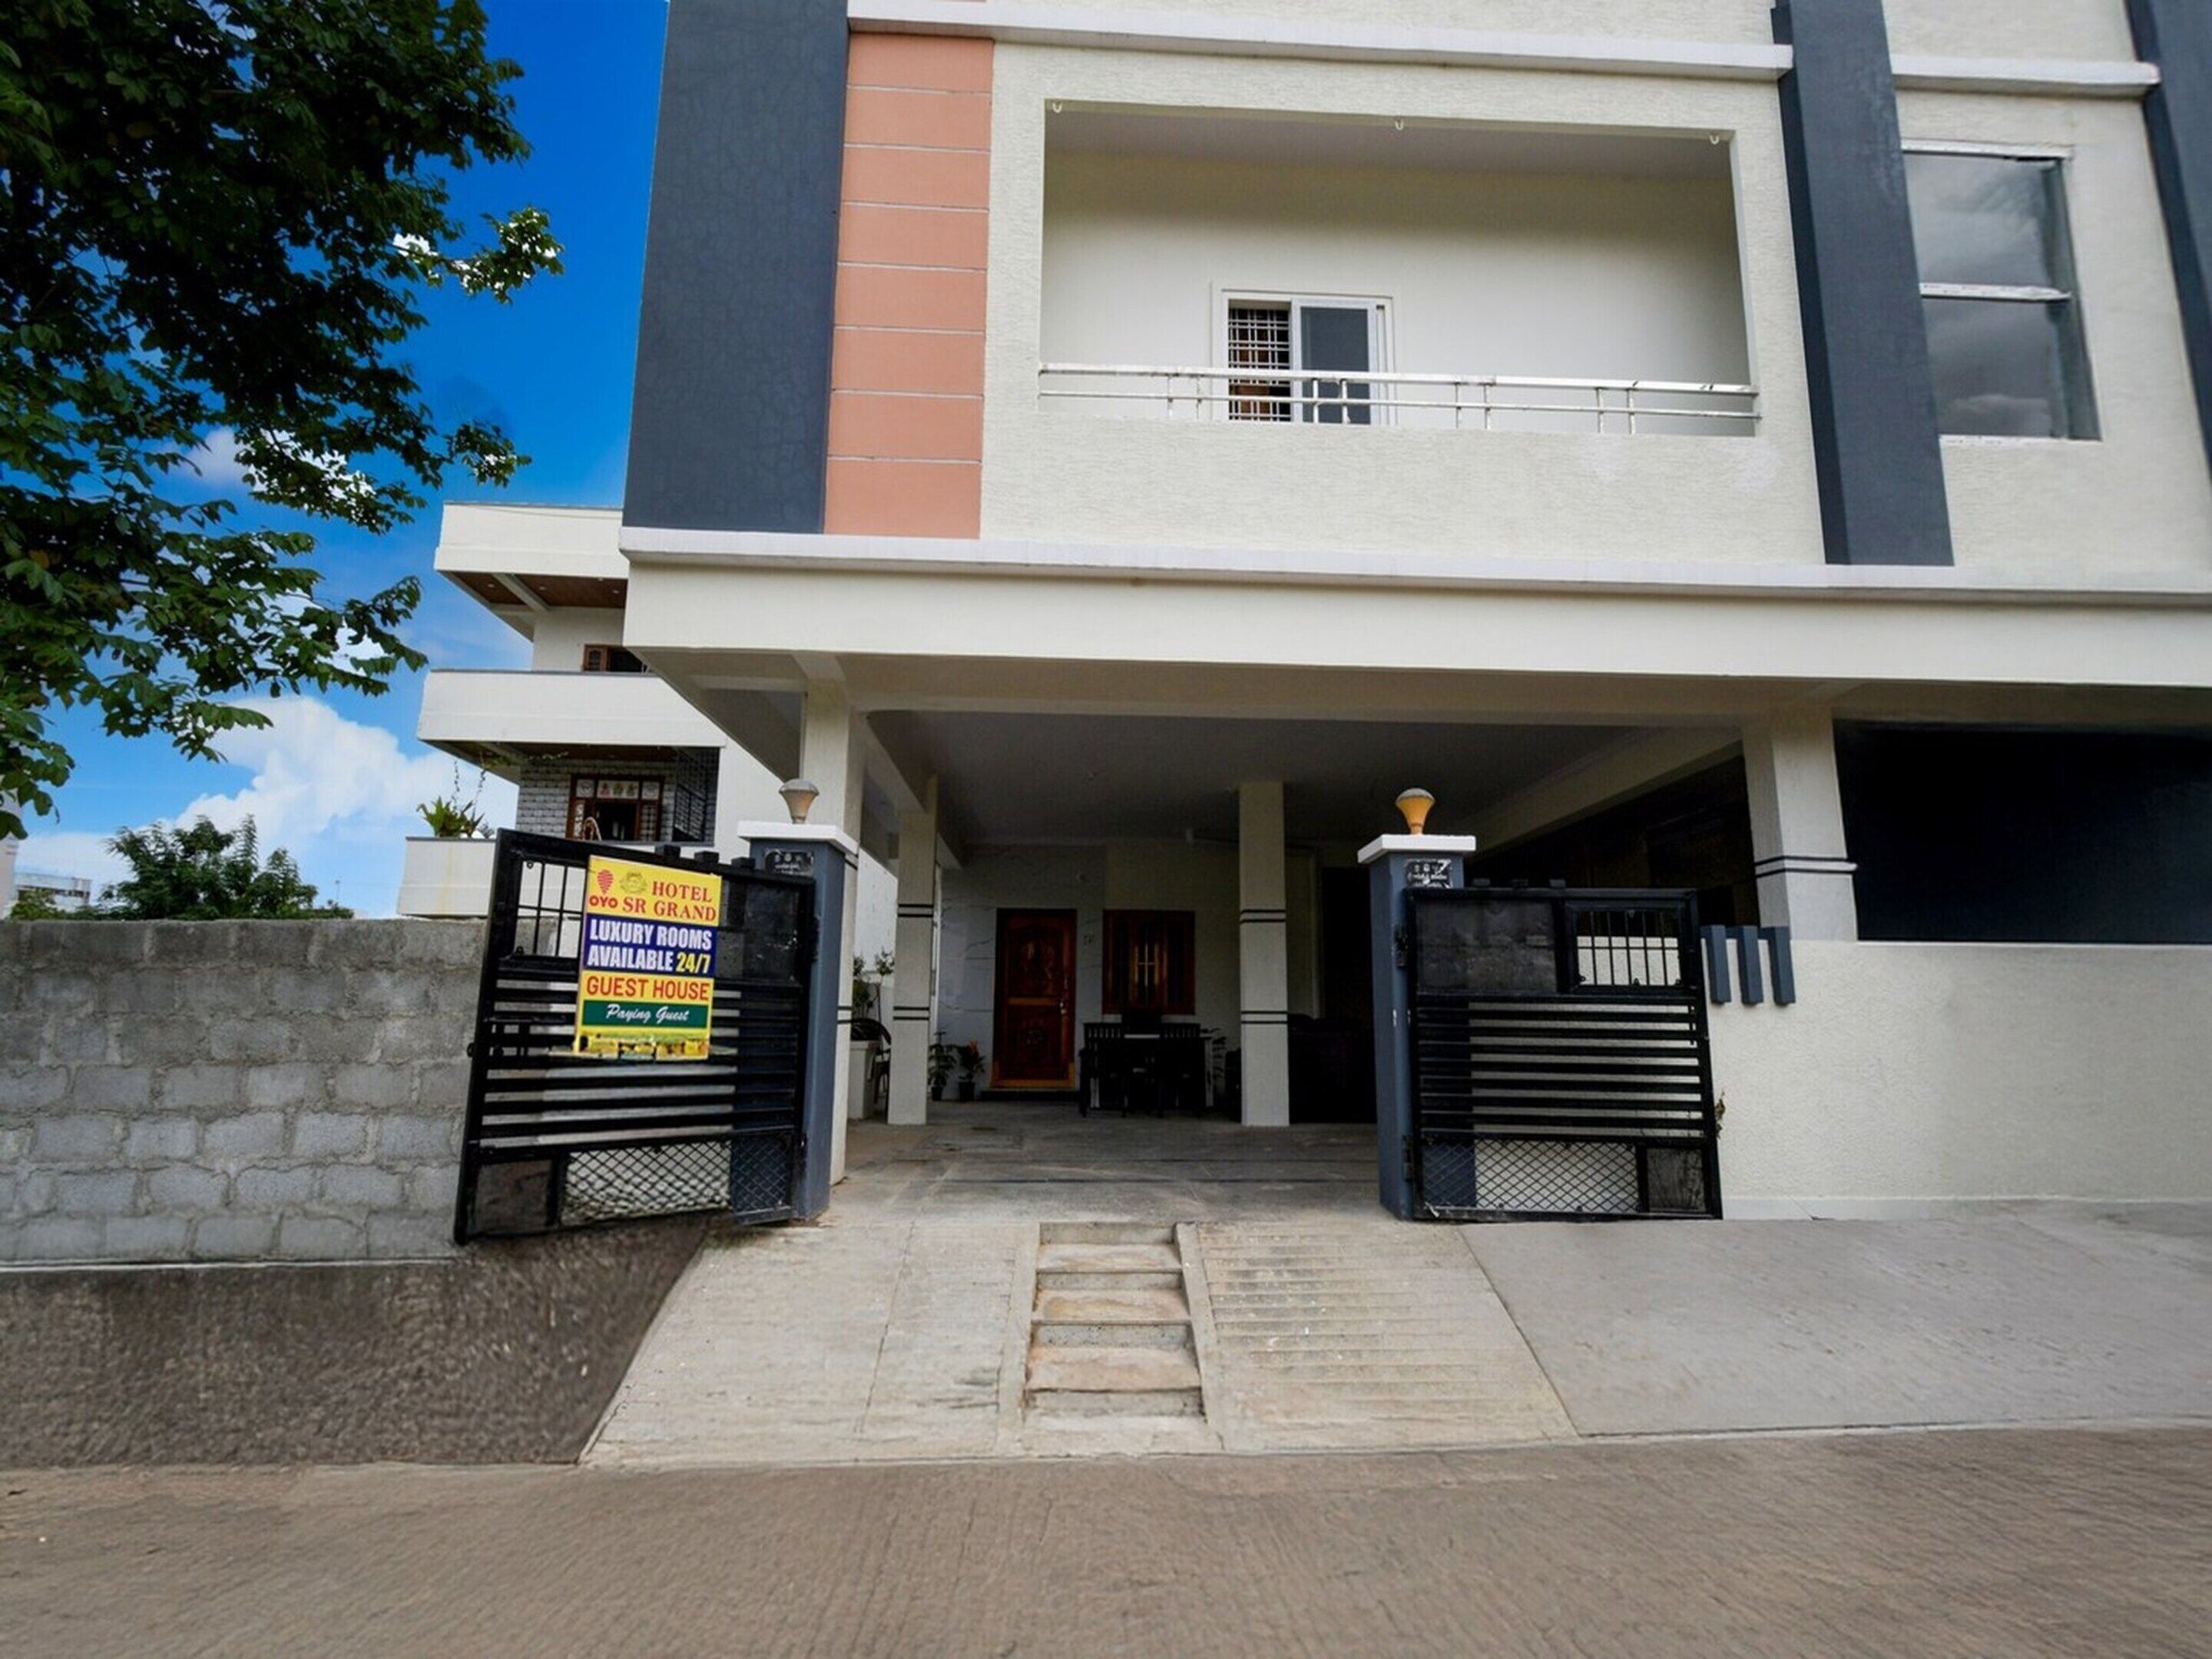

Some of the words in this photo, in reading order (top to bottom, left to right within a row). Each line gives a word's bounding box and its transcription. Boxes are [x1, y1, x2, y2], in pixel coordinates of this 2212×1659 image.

[589, 895, 618, 909] OYO
[651, 881, 713, 902] HOTEL
[622, 896, 646, 914] SR
[654, 900, 717, 921] GRAND
[590, 919, 654, 945] LUXURY
[656, 927, 712, 950] ROOMS
[587, 945, 674, 972] AVAILABLE
[676, 952, 711, 974] 24/7
[587, 975, 649, 997] GUEST
[653, 980, 710, 1001] HOUSE
[606, 1003, 651, 1023] Paying
[655, 1005, 690, 1024] Guest
